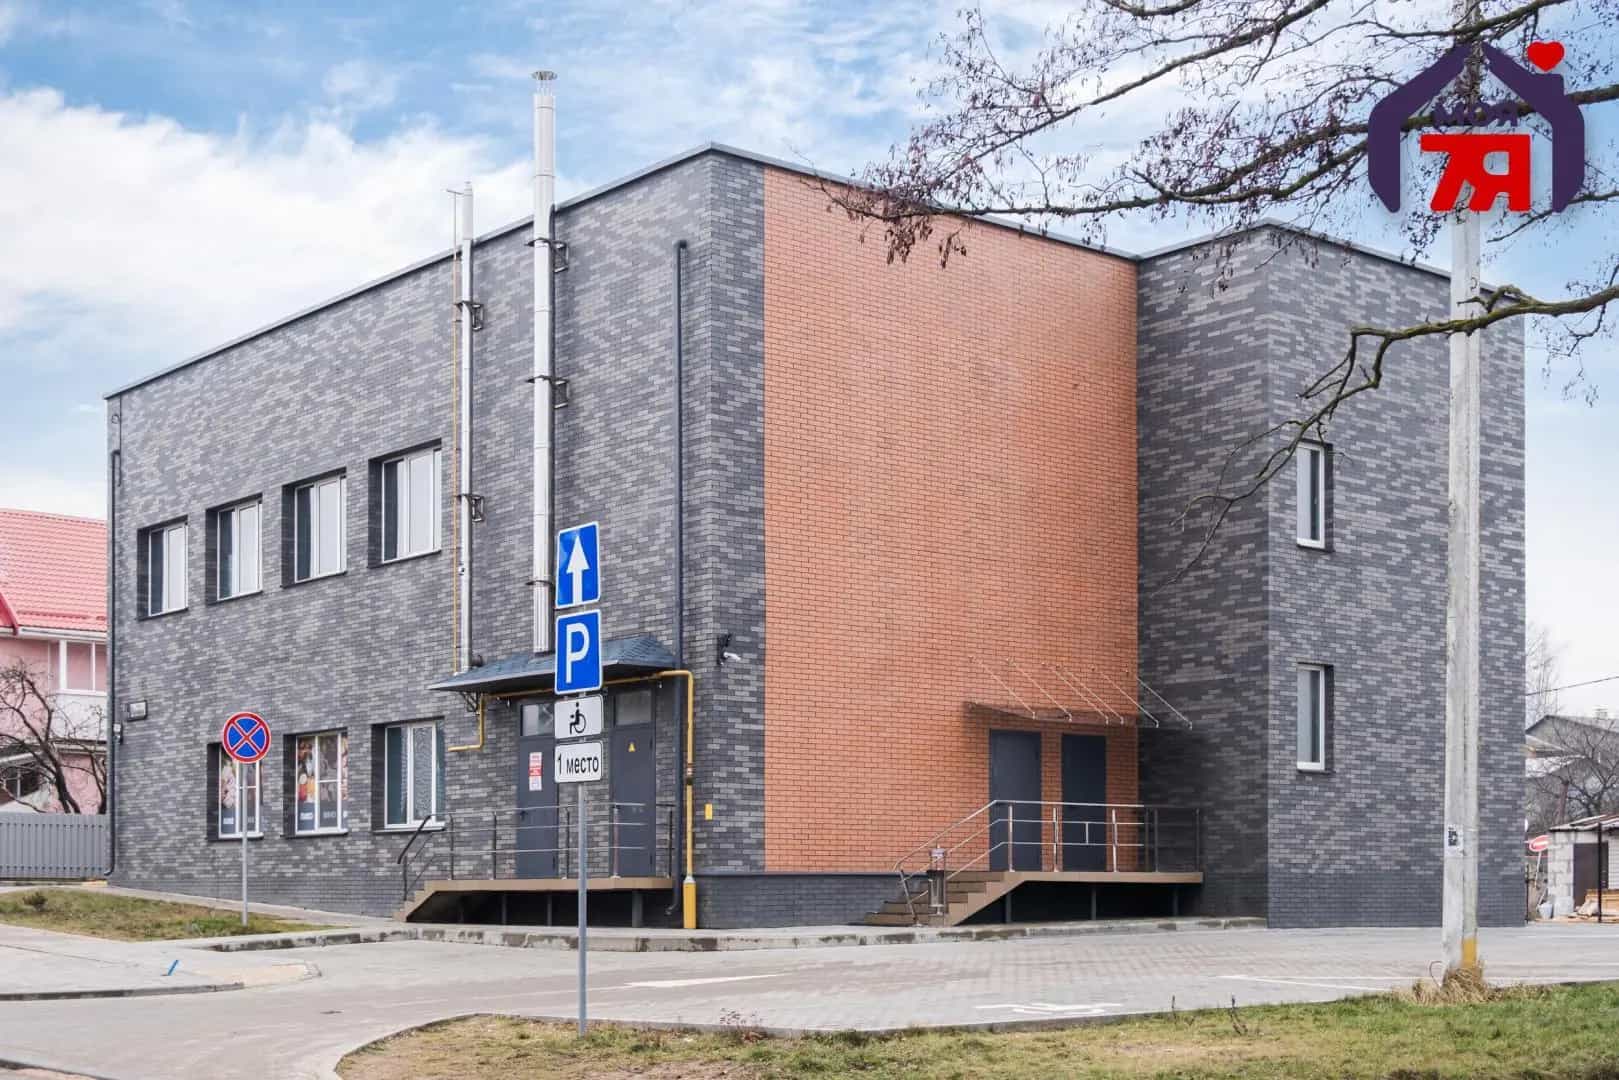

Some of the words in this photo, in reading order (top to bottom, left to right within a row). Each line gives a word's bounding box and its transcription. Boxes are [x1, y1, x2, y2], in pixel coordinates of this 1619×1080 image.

[565, 622, 590, 684] P
[557, 753, 562, 775] 1
[566, 757, 599, 775] место
